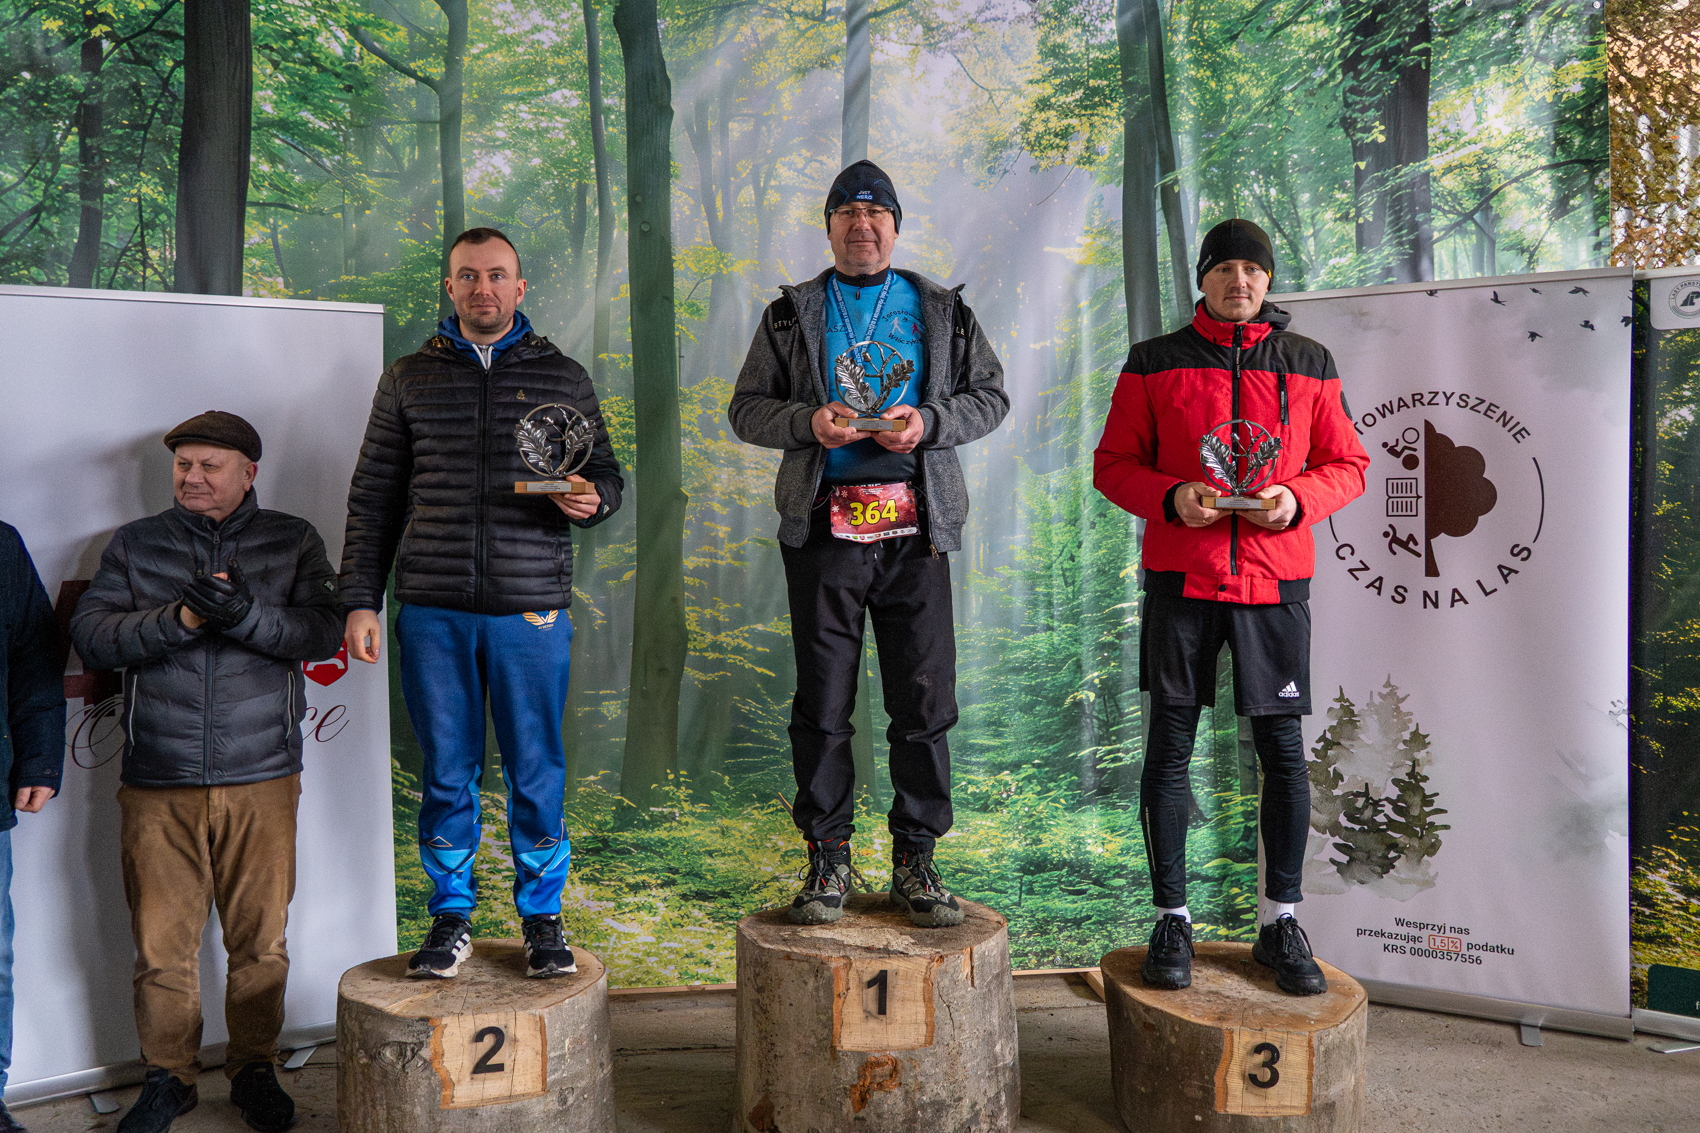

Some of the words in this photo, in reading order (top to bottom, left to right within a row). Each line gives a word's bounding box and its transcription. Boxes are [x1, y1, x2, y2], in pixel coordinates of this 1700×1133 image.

[1353, 391, 1532, 444] TOWARZYSZENIE
[849, 499, 899, 526] 364
[1335, 542, 1408, 604] CZAS
[1422, 587, 1469, 609] NA
[1475, 543, 1532, 597] LAS
[1356, 927, 1423, 944] przekazując
[1466, 941, 1515, 955] podatku
[1394, 917, 1447, 934] Wesprzyj
[1449, 925, 1471, 935] nas
[1383, 943, 1407, 955] KRS
[1409, 946, 1483, 965] 0000357556
[866, 969, 888, 1016] 1
[472, 1025, 506, 1075] 2
[1247, 1042, 1280, 1089] 3
